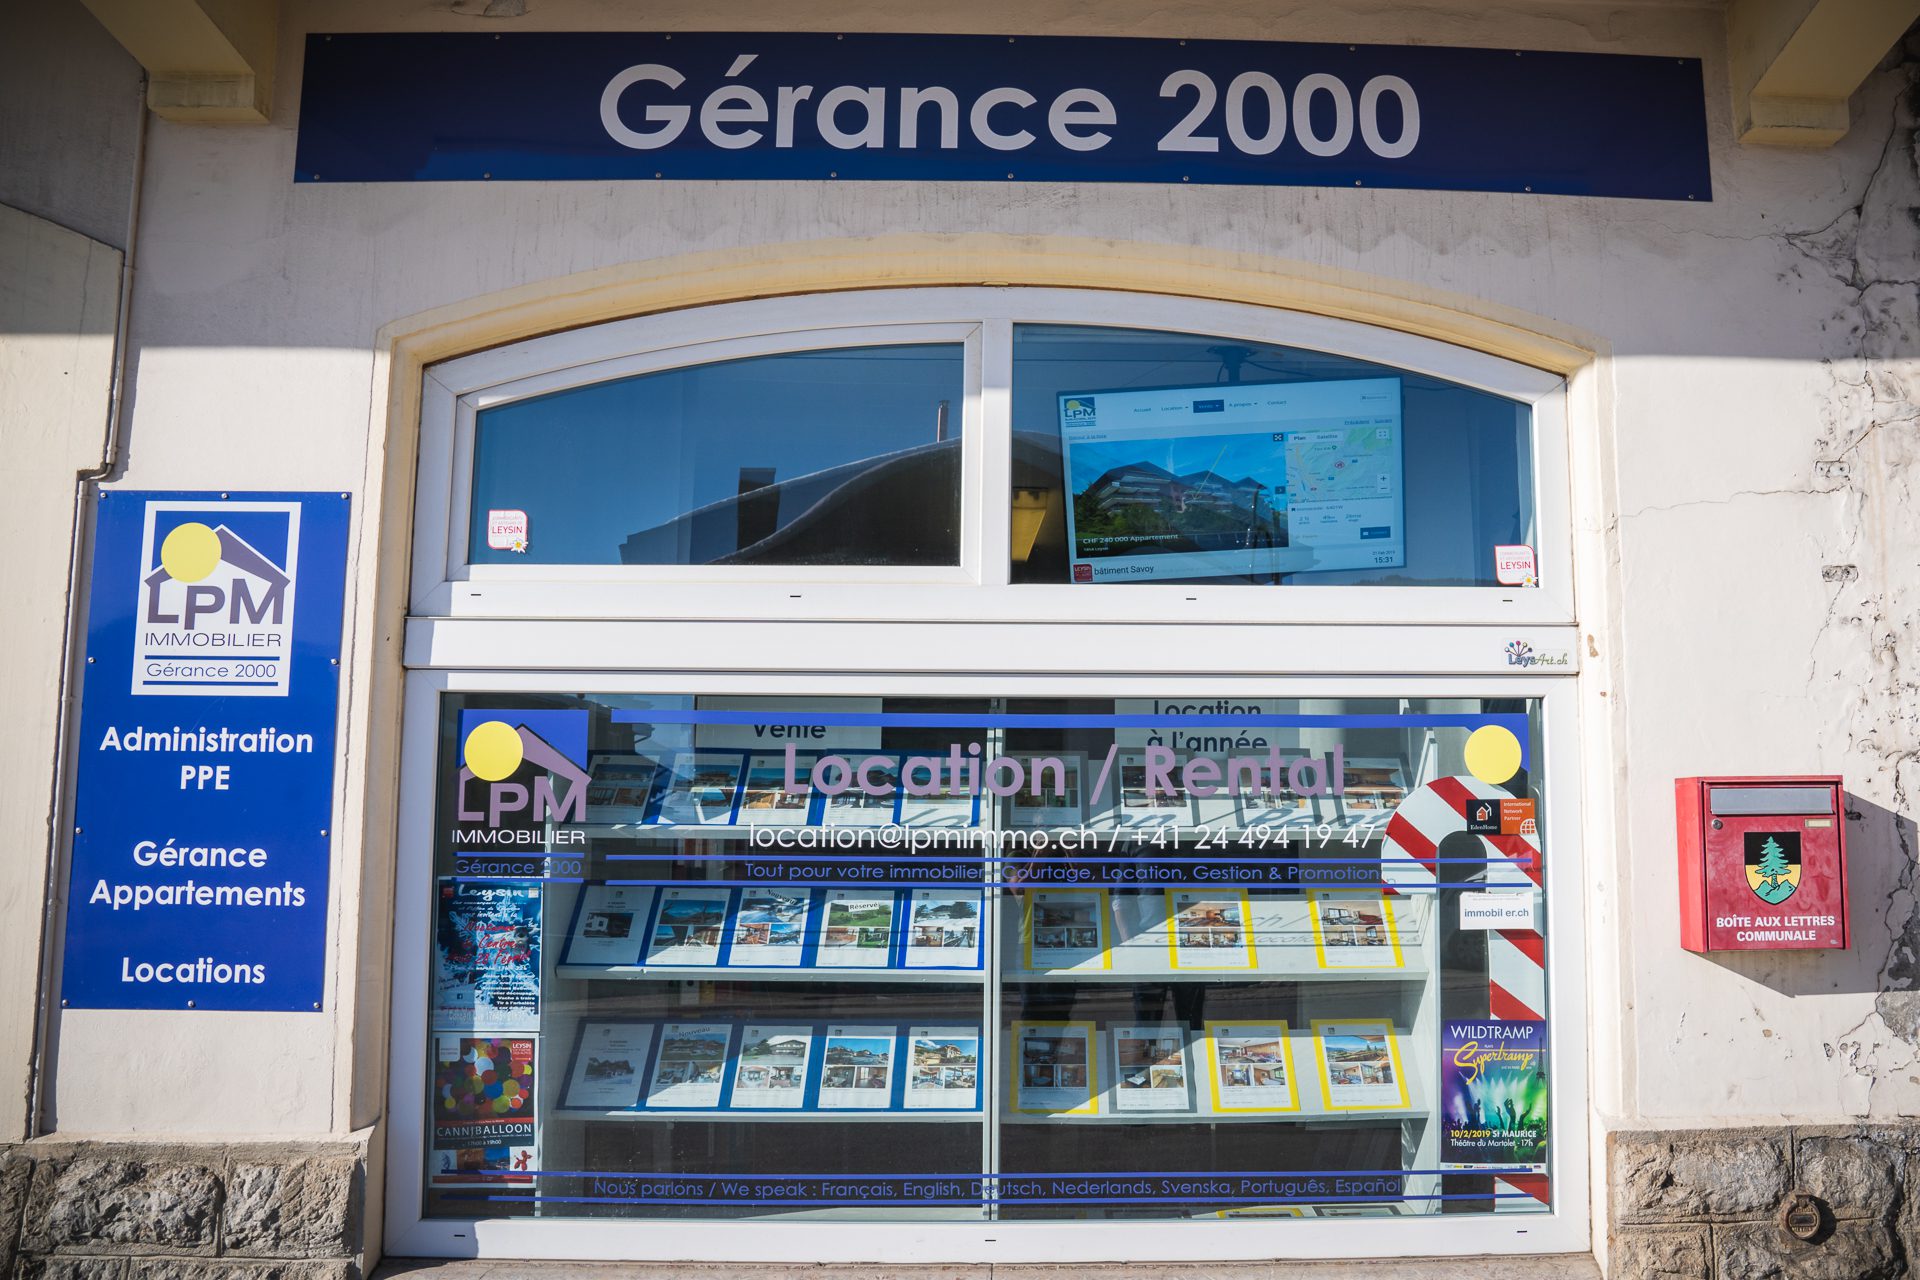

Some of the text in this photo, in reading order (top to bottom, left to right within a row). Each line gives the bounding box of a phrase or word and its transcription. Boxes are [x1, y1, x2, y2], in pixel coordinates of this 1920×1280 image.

[600, 54, 1421, 159] Gérance 2000
[1064, 408, 1097, 419] LPM
[491, 525, 523, 534] LEYSIN
[1129, 533, 1179, 543] Appartement
[1374, 556, 1393, 564] 15:31
[1500, 561, 1531, 570] LEYSIN
[1094, 565, 1154, 575] bâtiment Savoy
[145, 577, 286, 630] LPM
[145, 632, 281, 647] IMMOBILIER
[146, 662, 276, 678] Gérance 2000
[99, 726, 313, 753] Administration
[180, 765, 230, 790] PPE
[785, 742, 1344, 805] Location / Rental
[457, 776, 588, 828] LPM
[452, 830, 586, 845] IMMOBILIER
[750, 822, 1375, 855] location@lpmimmo.ch / +41 24 494 19 47
[133, 838, 268, 868] Gérance
[455, 859, 582, 875] Gérance 2000
[745, 863, 1380, 883] Tout pour votre immobilier Courtage, Location, Gestion & Promotion
[89, 879, 306, 911] Appartements
[458, 884, 525, 901] Leysin
[849, 901, 879, 910] Réservé
[1464, 908, 1529, 918] immobiler.ch
[1716, 913, 1835, 928] BOÎTE AUX LETTRES
[1736, 930, 1816, 942] COMMUNALE
[121, 957, 266, 984] Locations
[1450, 1025, 1533, 1040] WILDTRAMP
[1453, 1041, 1534, 1085] Supertramp
[1450, 1130, 1491, 1138] 10/2/2019
[1502, 1130, 1537, 1138] MAURICE
[1450, 1139, 1475, 1147] Théâtre
[1477, 1139, 1486, 1147] du
[1521, 1139, 1534, 1147] 17h
[594, 1180, 636, 1195] Nous
[641, 1181, 704, 1198] parlons
[708, 1182, 717, 1198] /
[721, 1182, 749, 1196] We
[755, 1182, 807, 1199] speak
[822, 1182, 898, 1199] Français,
[903, 1182, 966, 1199] English,
[971, 1181, 1046, 1197] Deutsch,
[1052, 1180, 1157, 1196] Nederlands,
[1161, 1179, 1235, 1196] Svenska,
[1241, 1179, 1330, 1197] Português,
[1335, 1178, 1400, 1195] Español
